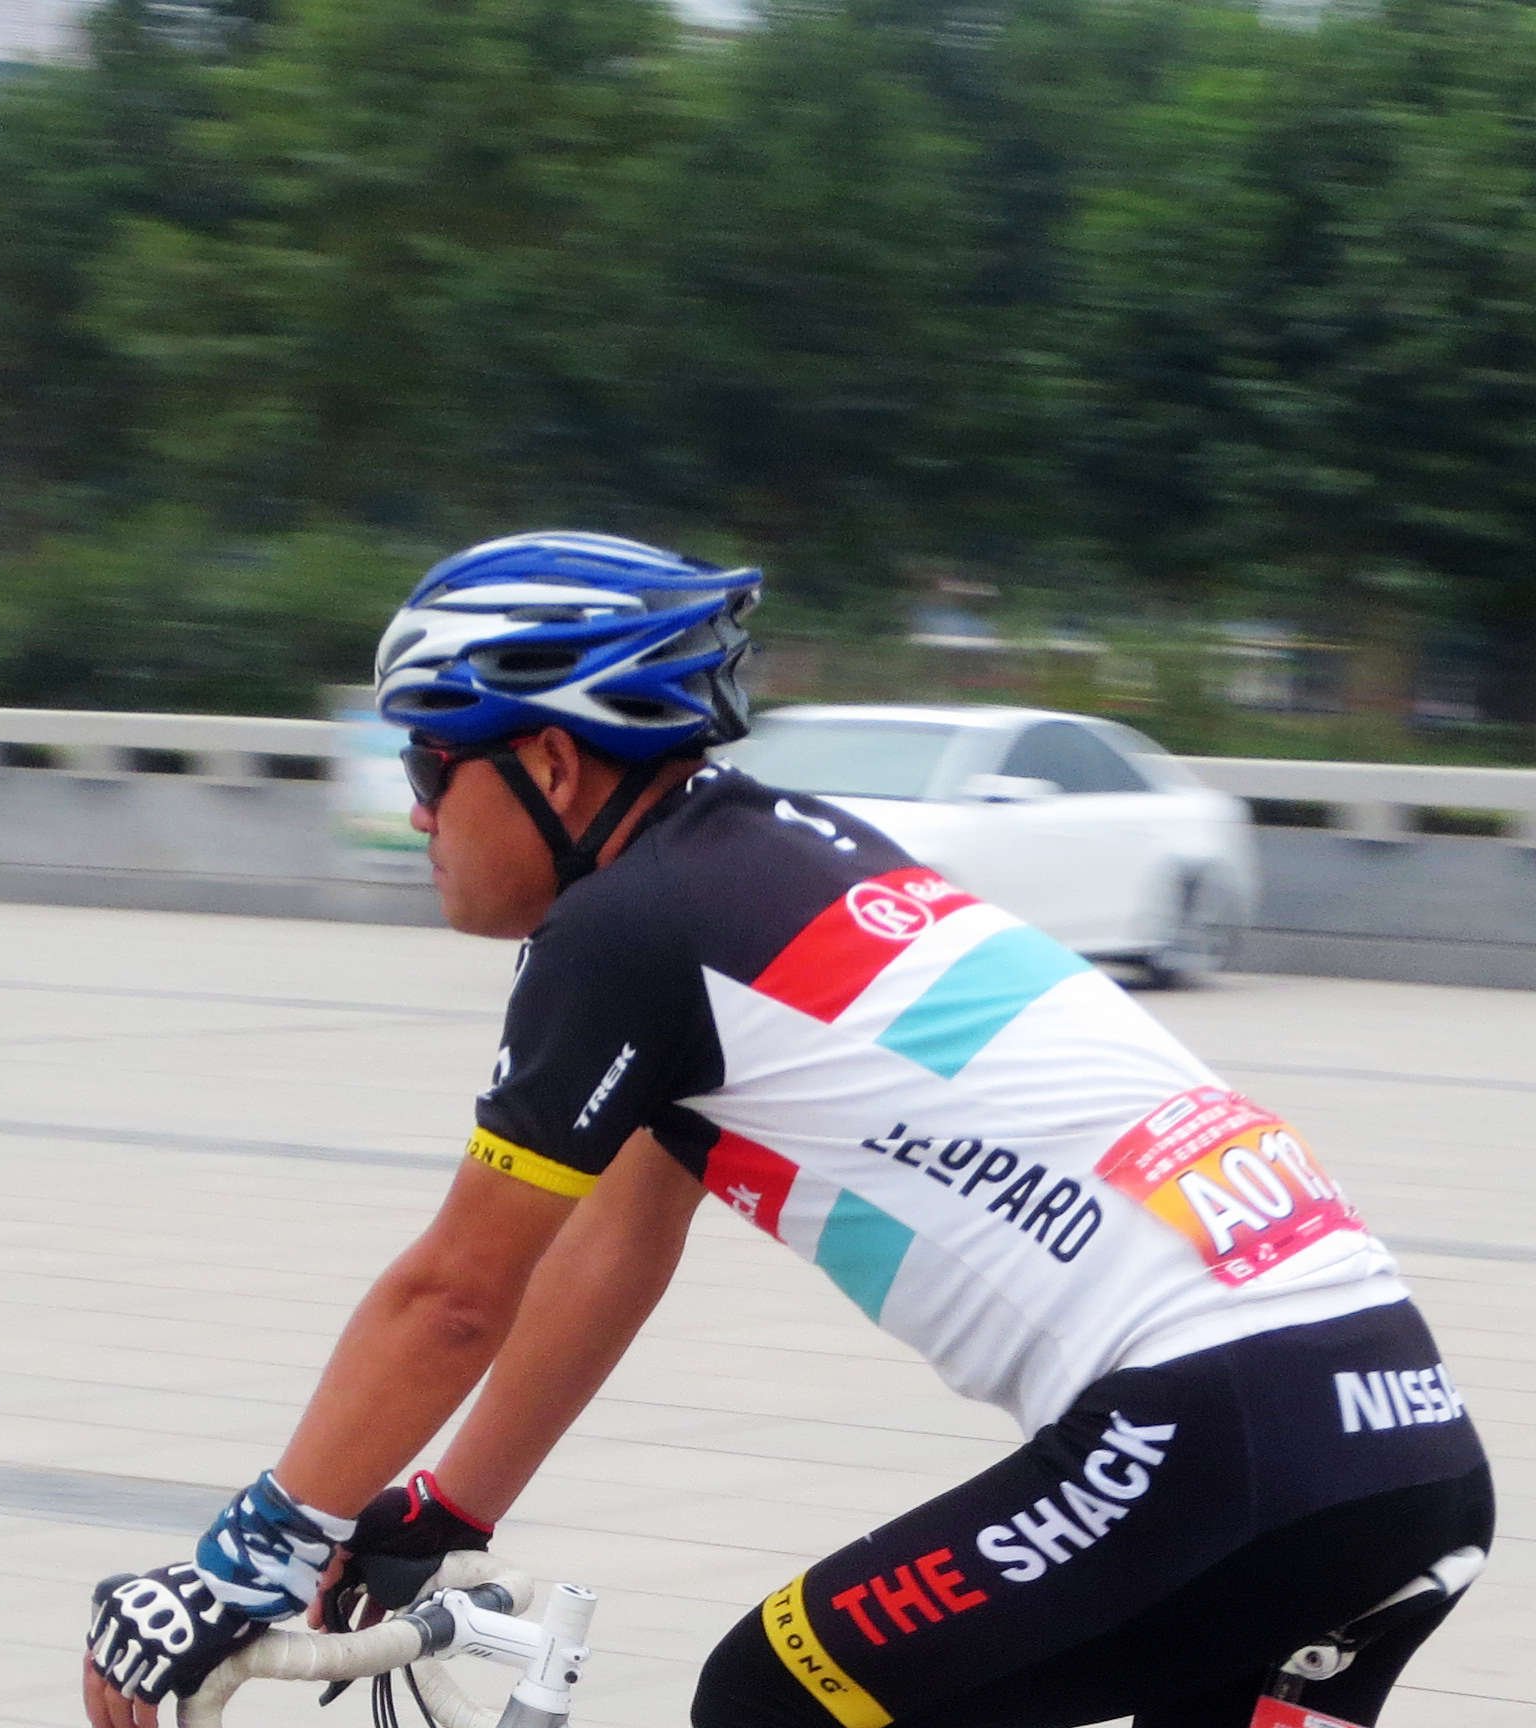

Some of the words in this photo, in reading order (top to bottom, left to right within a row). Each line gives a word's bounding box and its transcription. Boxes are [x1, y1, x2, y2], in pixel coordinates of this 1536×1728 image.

[572, 1041, 638, 1130] TREK
[830, 1546, 990, 1648] THE
[975, 1410, 1177, 1583] SHACK
